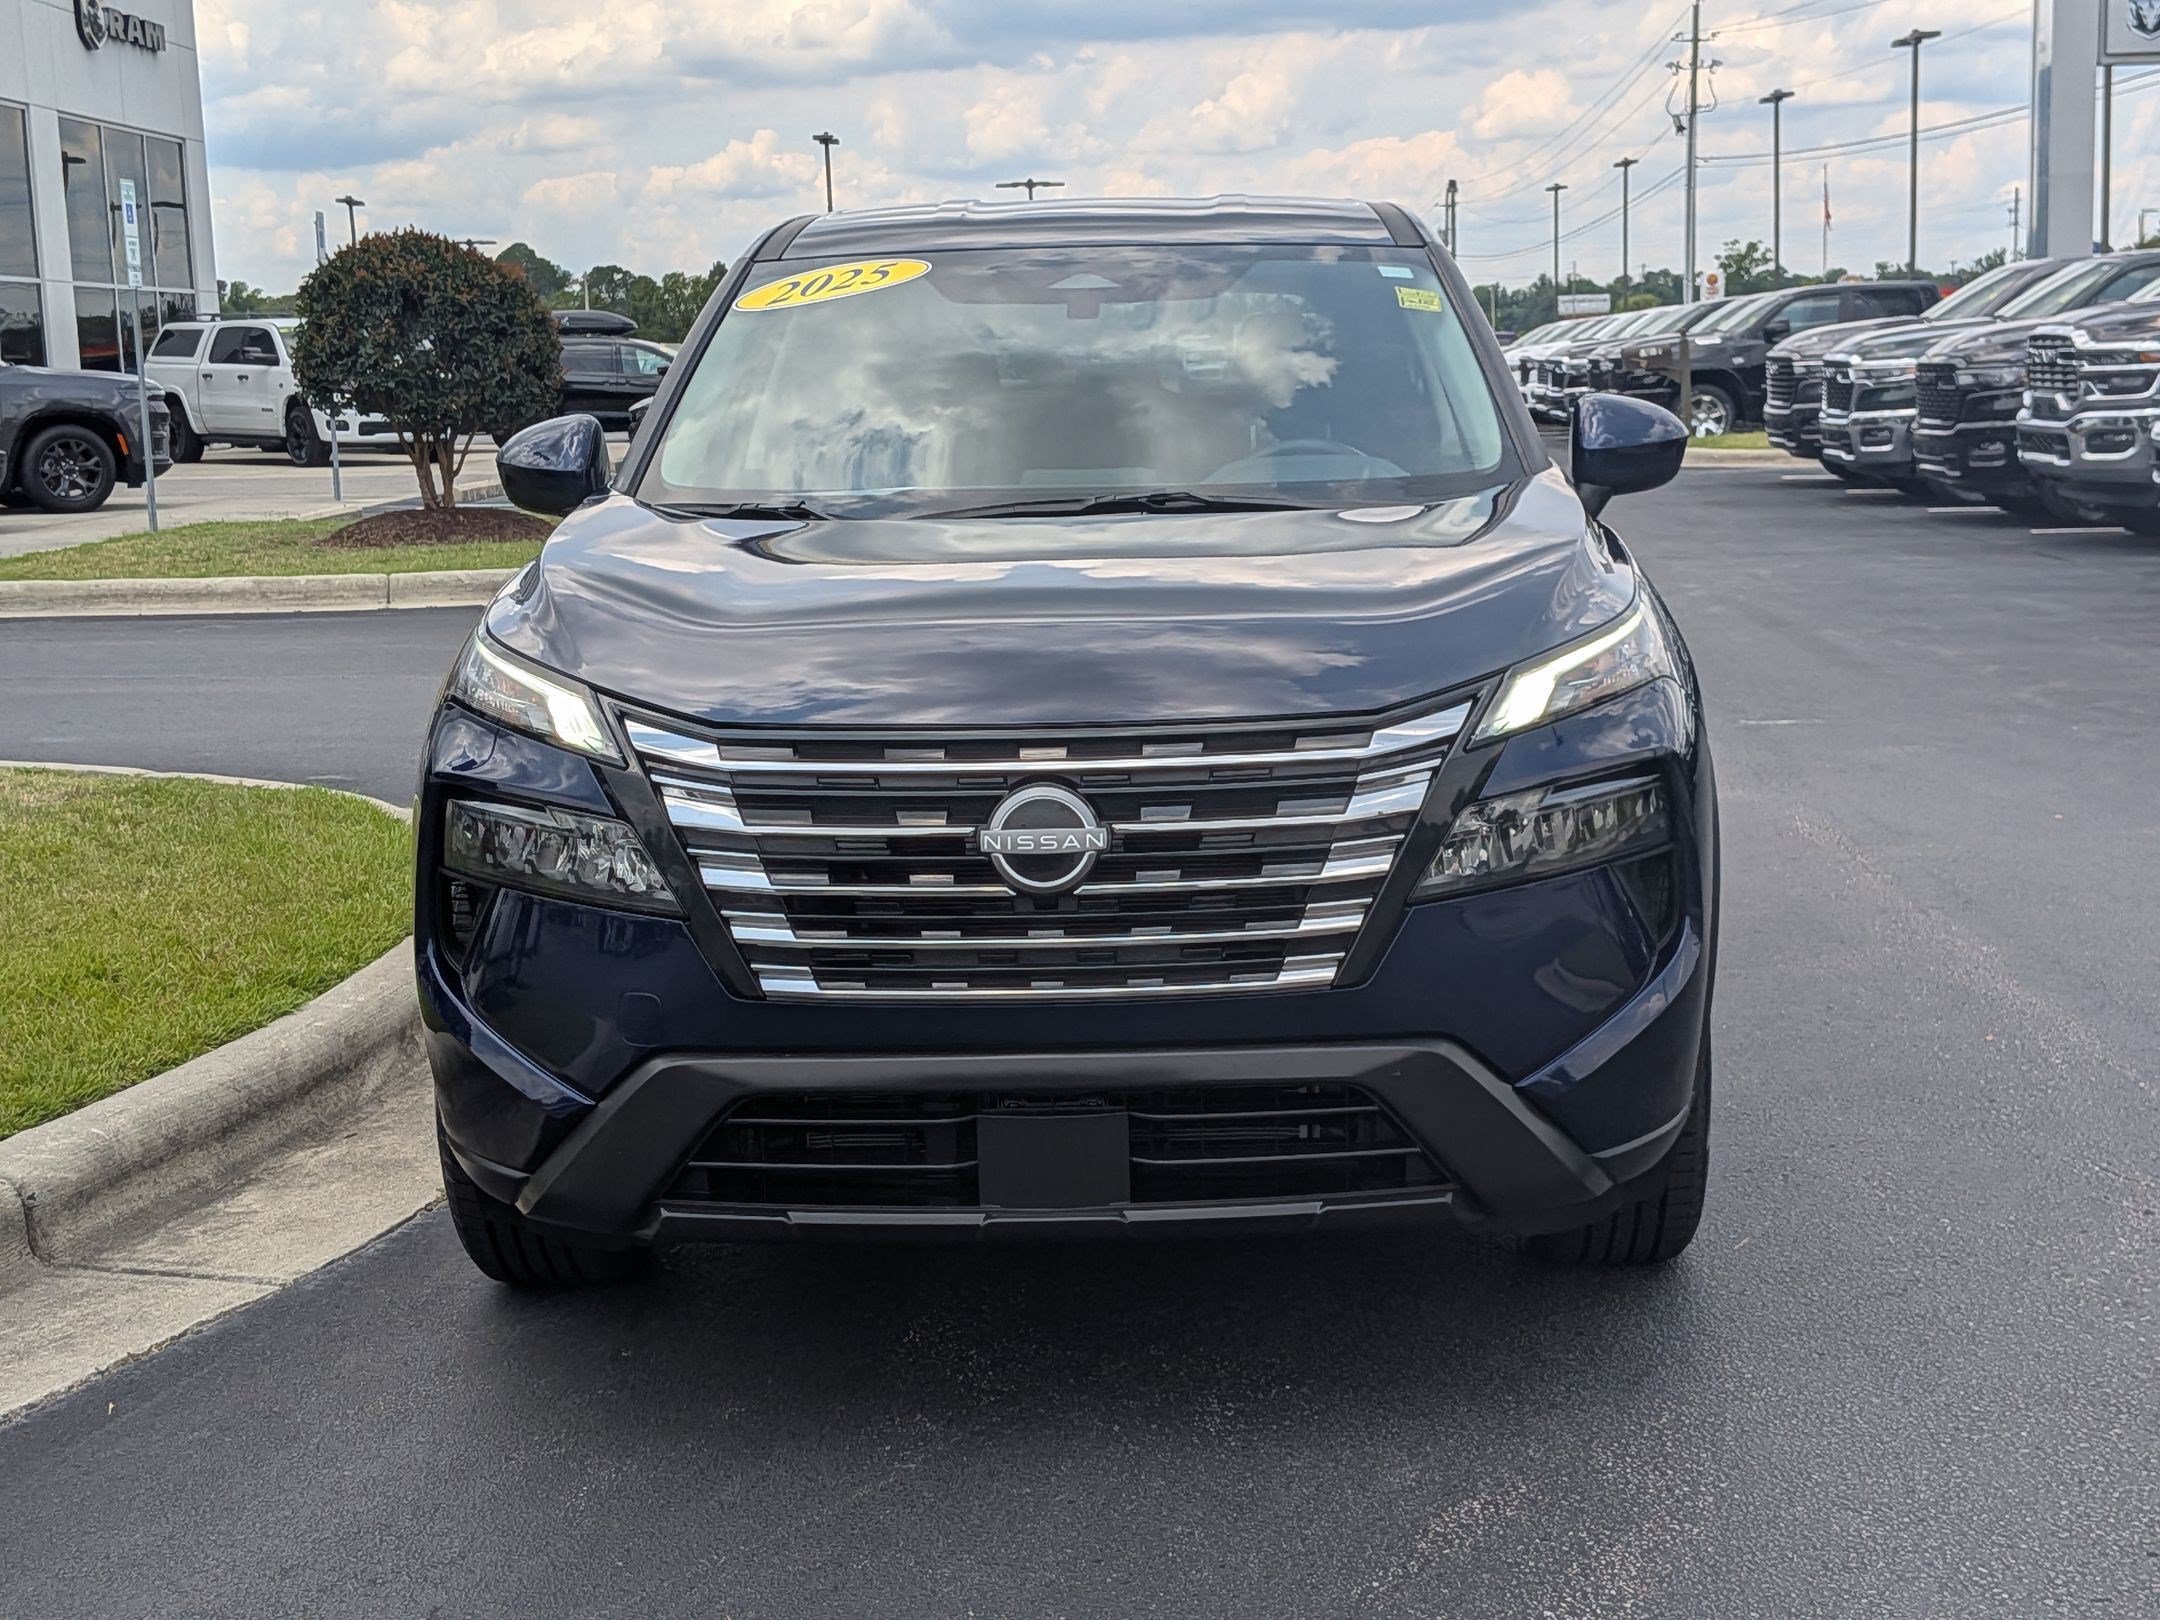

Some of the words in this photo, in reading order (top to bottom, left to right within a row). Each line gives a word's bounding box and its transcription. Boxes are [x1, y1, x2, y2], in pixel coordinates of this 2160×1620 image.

[103, 8, 166, 53] RAM
[766, 263, 898, 306] 2025
[984, 833, 1103, 850] NISSAN
